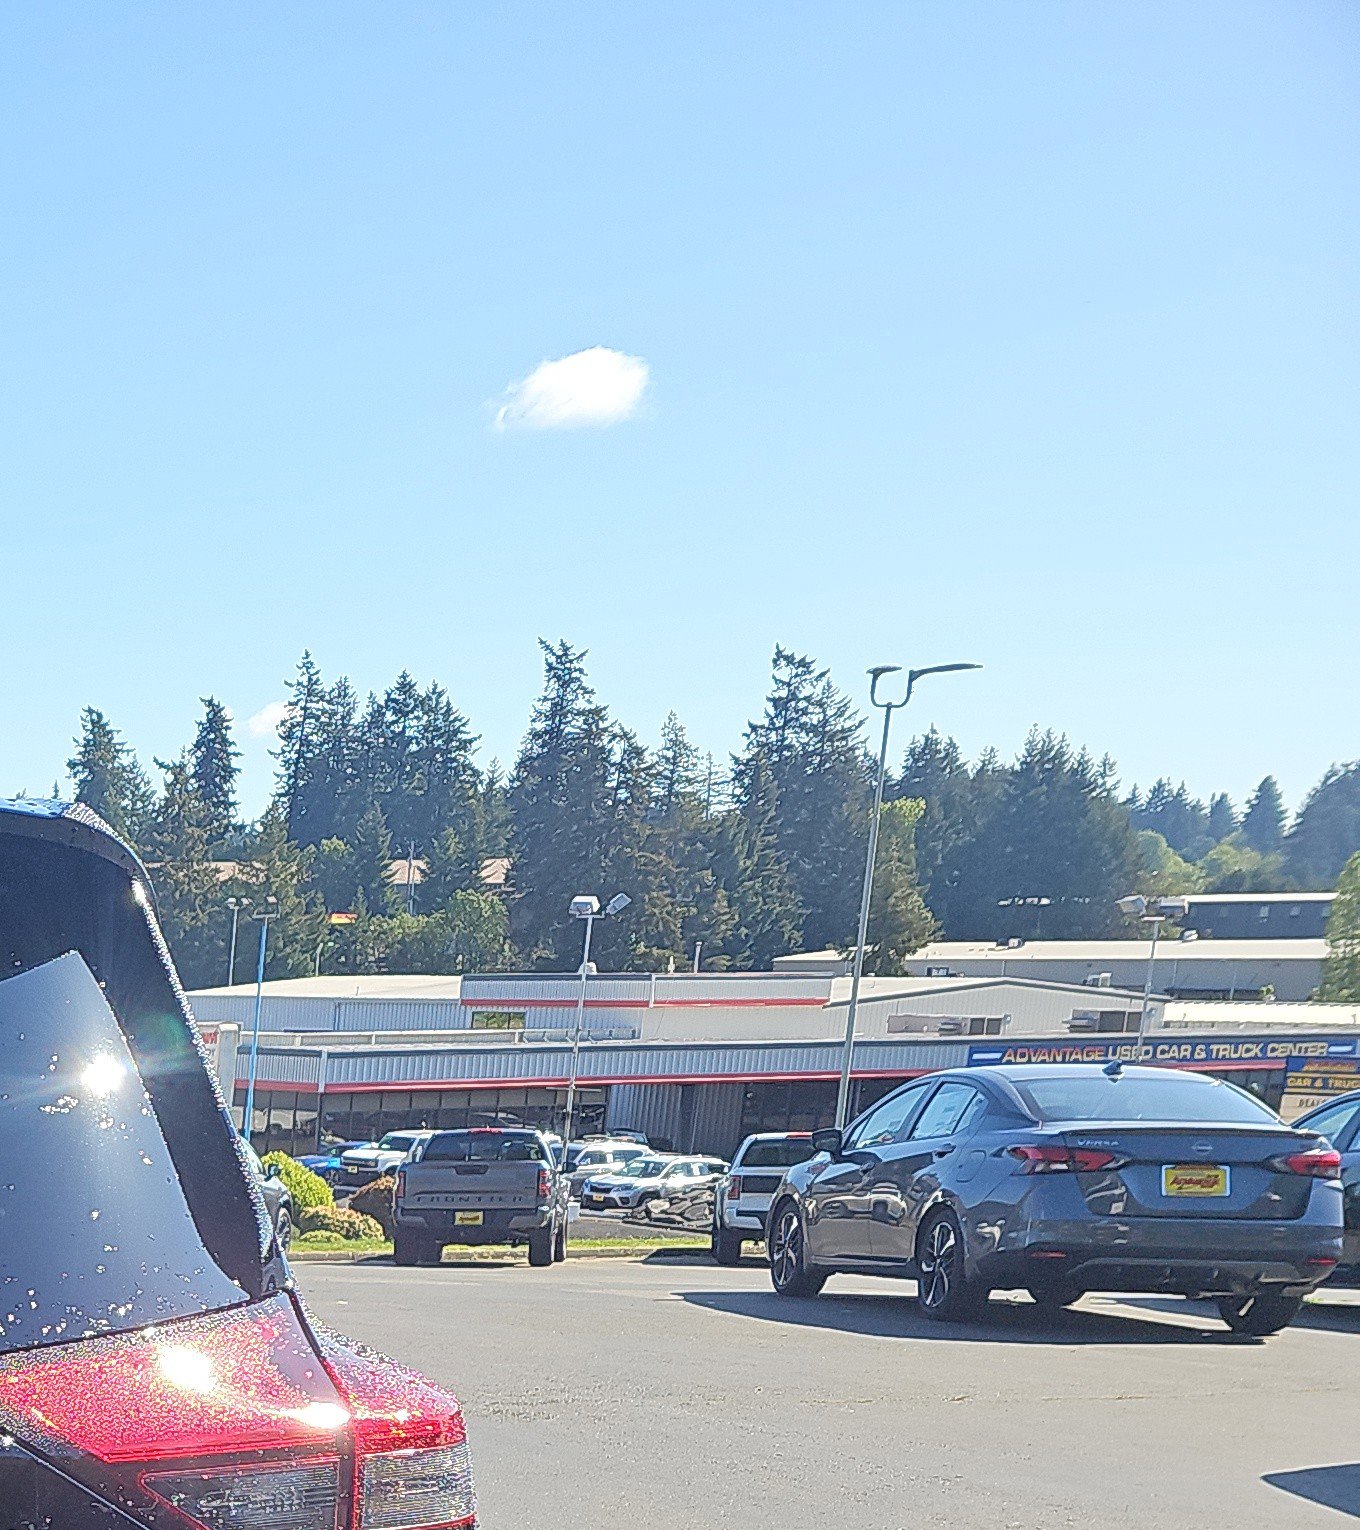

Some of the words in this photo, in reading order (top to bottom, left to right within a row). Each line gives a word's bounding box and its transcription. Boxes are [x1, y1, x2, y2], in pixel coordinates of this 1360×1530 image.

[1002, 1044, 1105, 1063] ADVANTAGE
[1156, 1044, 1192, 1060] CAR
[1194, 1044, 1206, 1060] &
[1210, 1042, 1263, 1059] TRUCK
[1266, 1041, 1328, 1058] CENTER
[1327, 1077, 1360, 1089] TRUC
